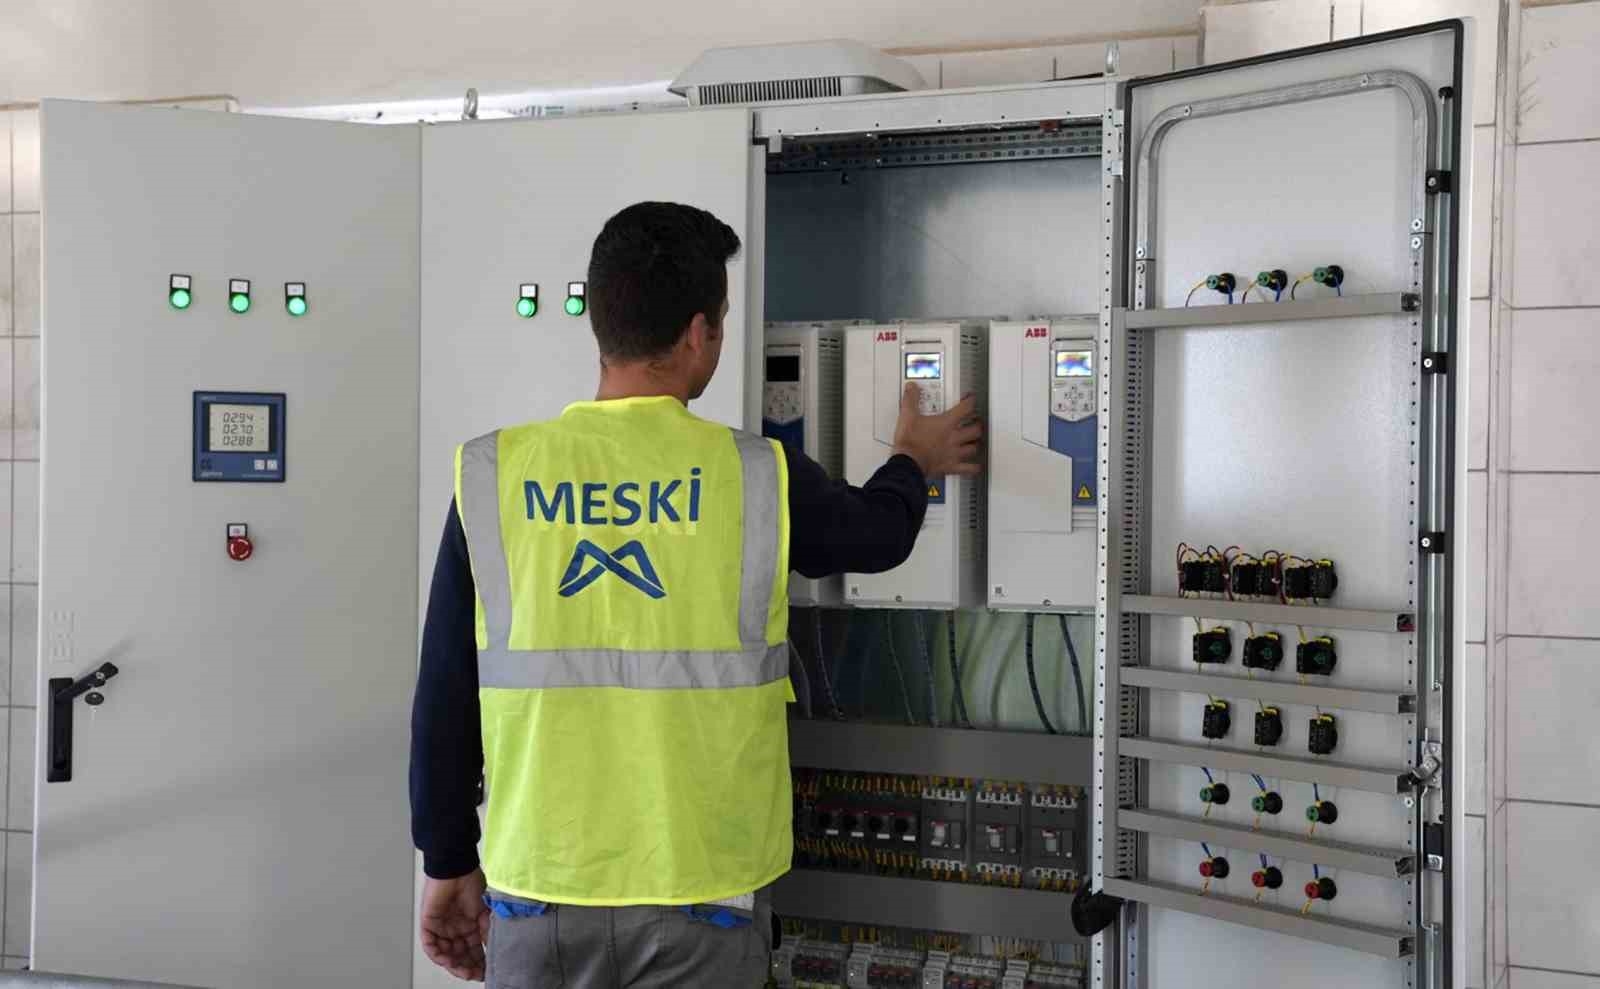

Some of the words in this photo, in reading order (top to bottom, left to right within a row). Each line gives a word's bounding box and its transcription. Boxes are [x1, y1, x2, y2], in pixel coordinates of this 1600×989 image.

[876, 332, 898, 342] ABB
[1025, 328, 1047, 338] ABB
[524, 467, 701, 526] MESKİ
